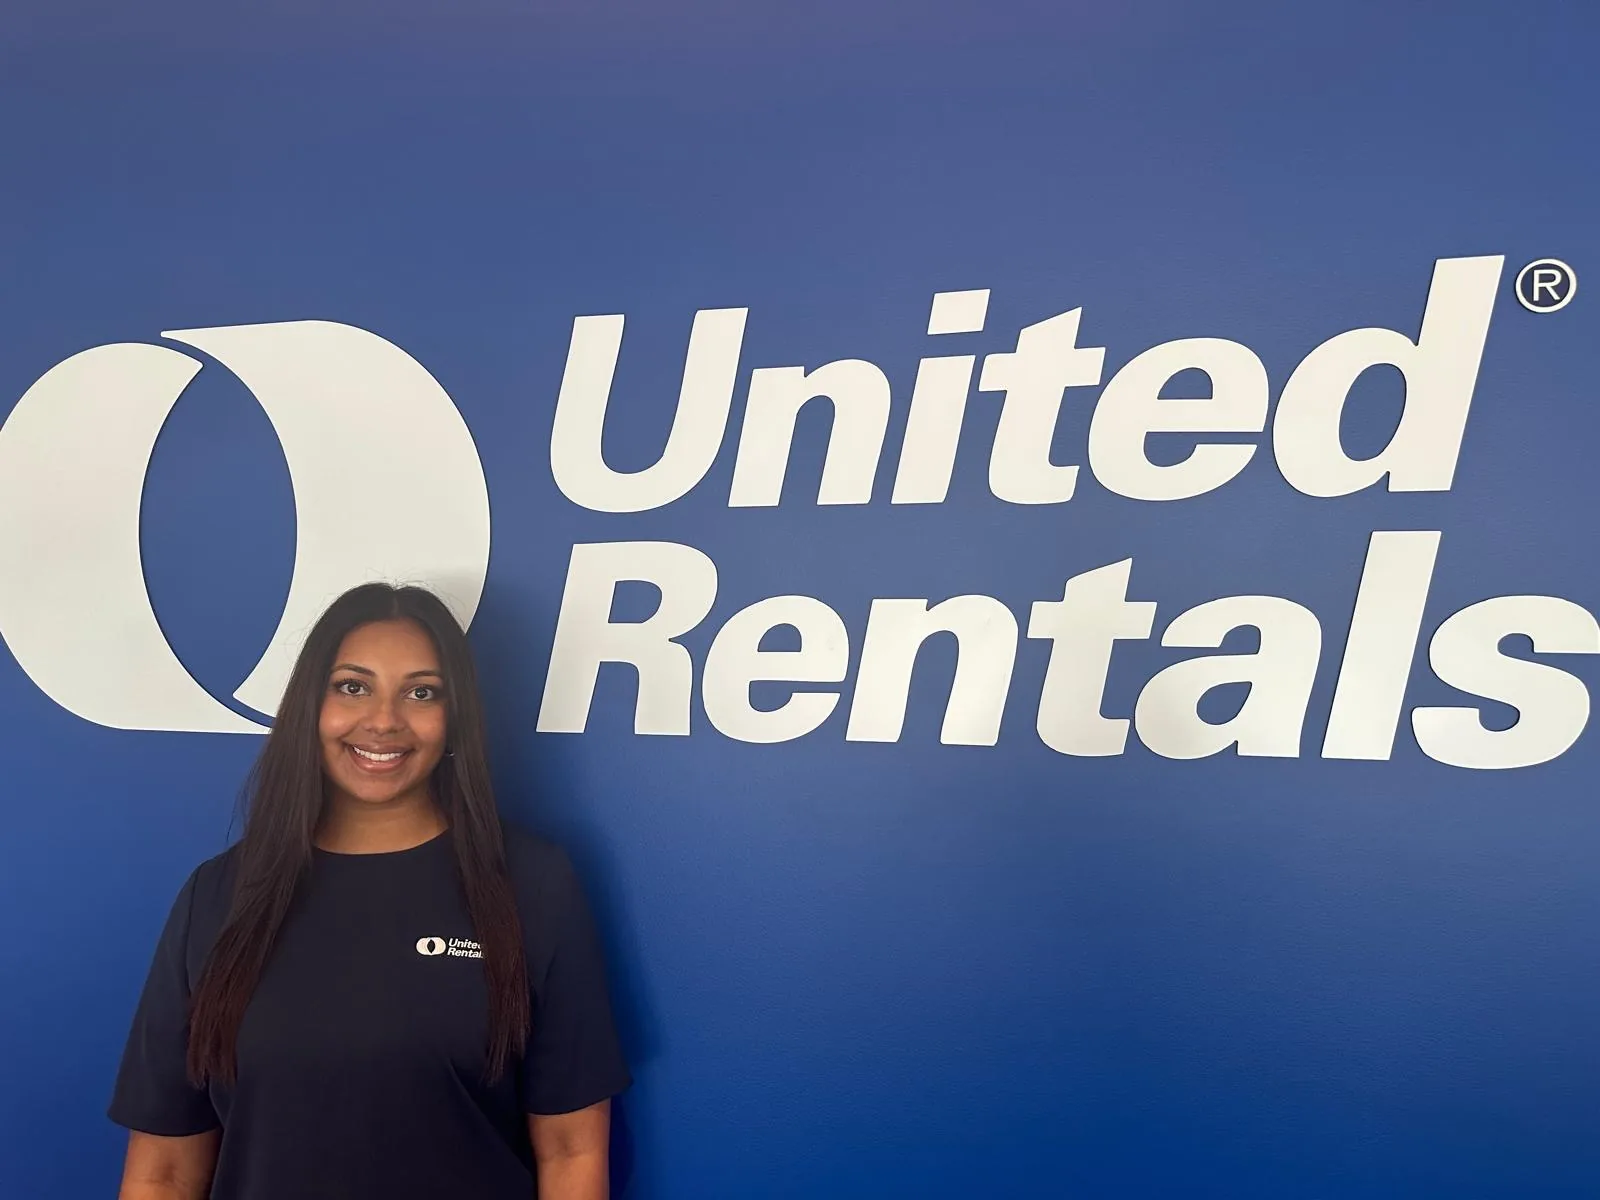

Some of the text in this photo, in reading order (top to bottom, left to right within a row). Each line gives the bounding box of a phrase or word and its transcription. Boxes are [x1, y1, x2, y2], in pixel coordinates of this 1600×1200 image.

[550, 254, 1505, 513] United
[536, 530, 1600, 770] Rentals
[447, 947, 483, 958] Rental
